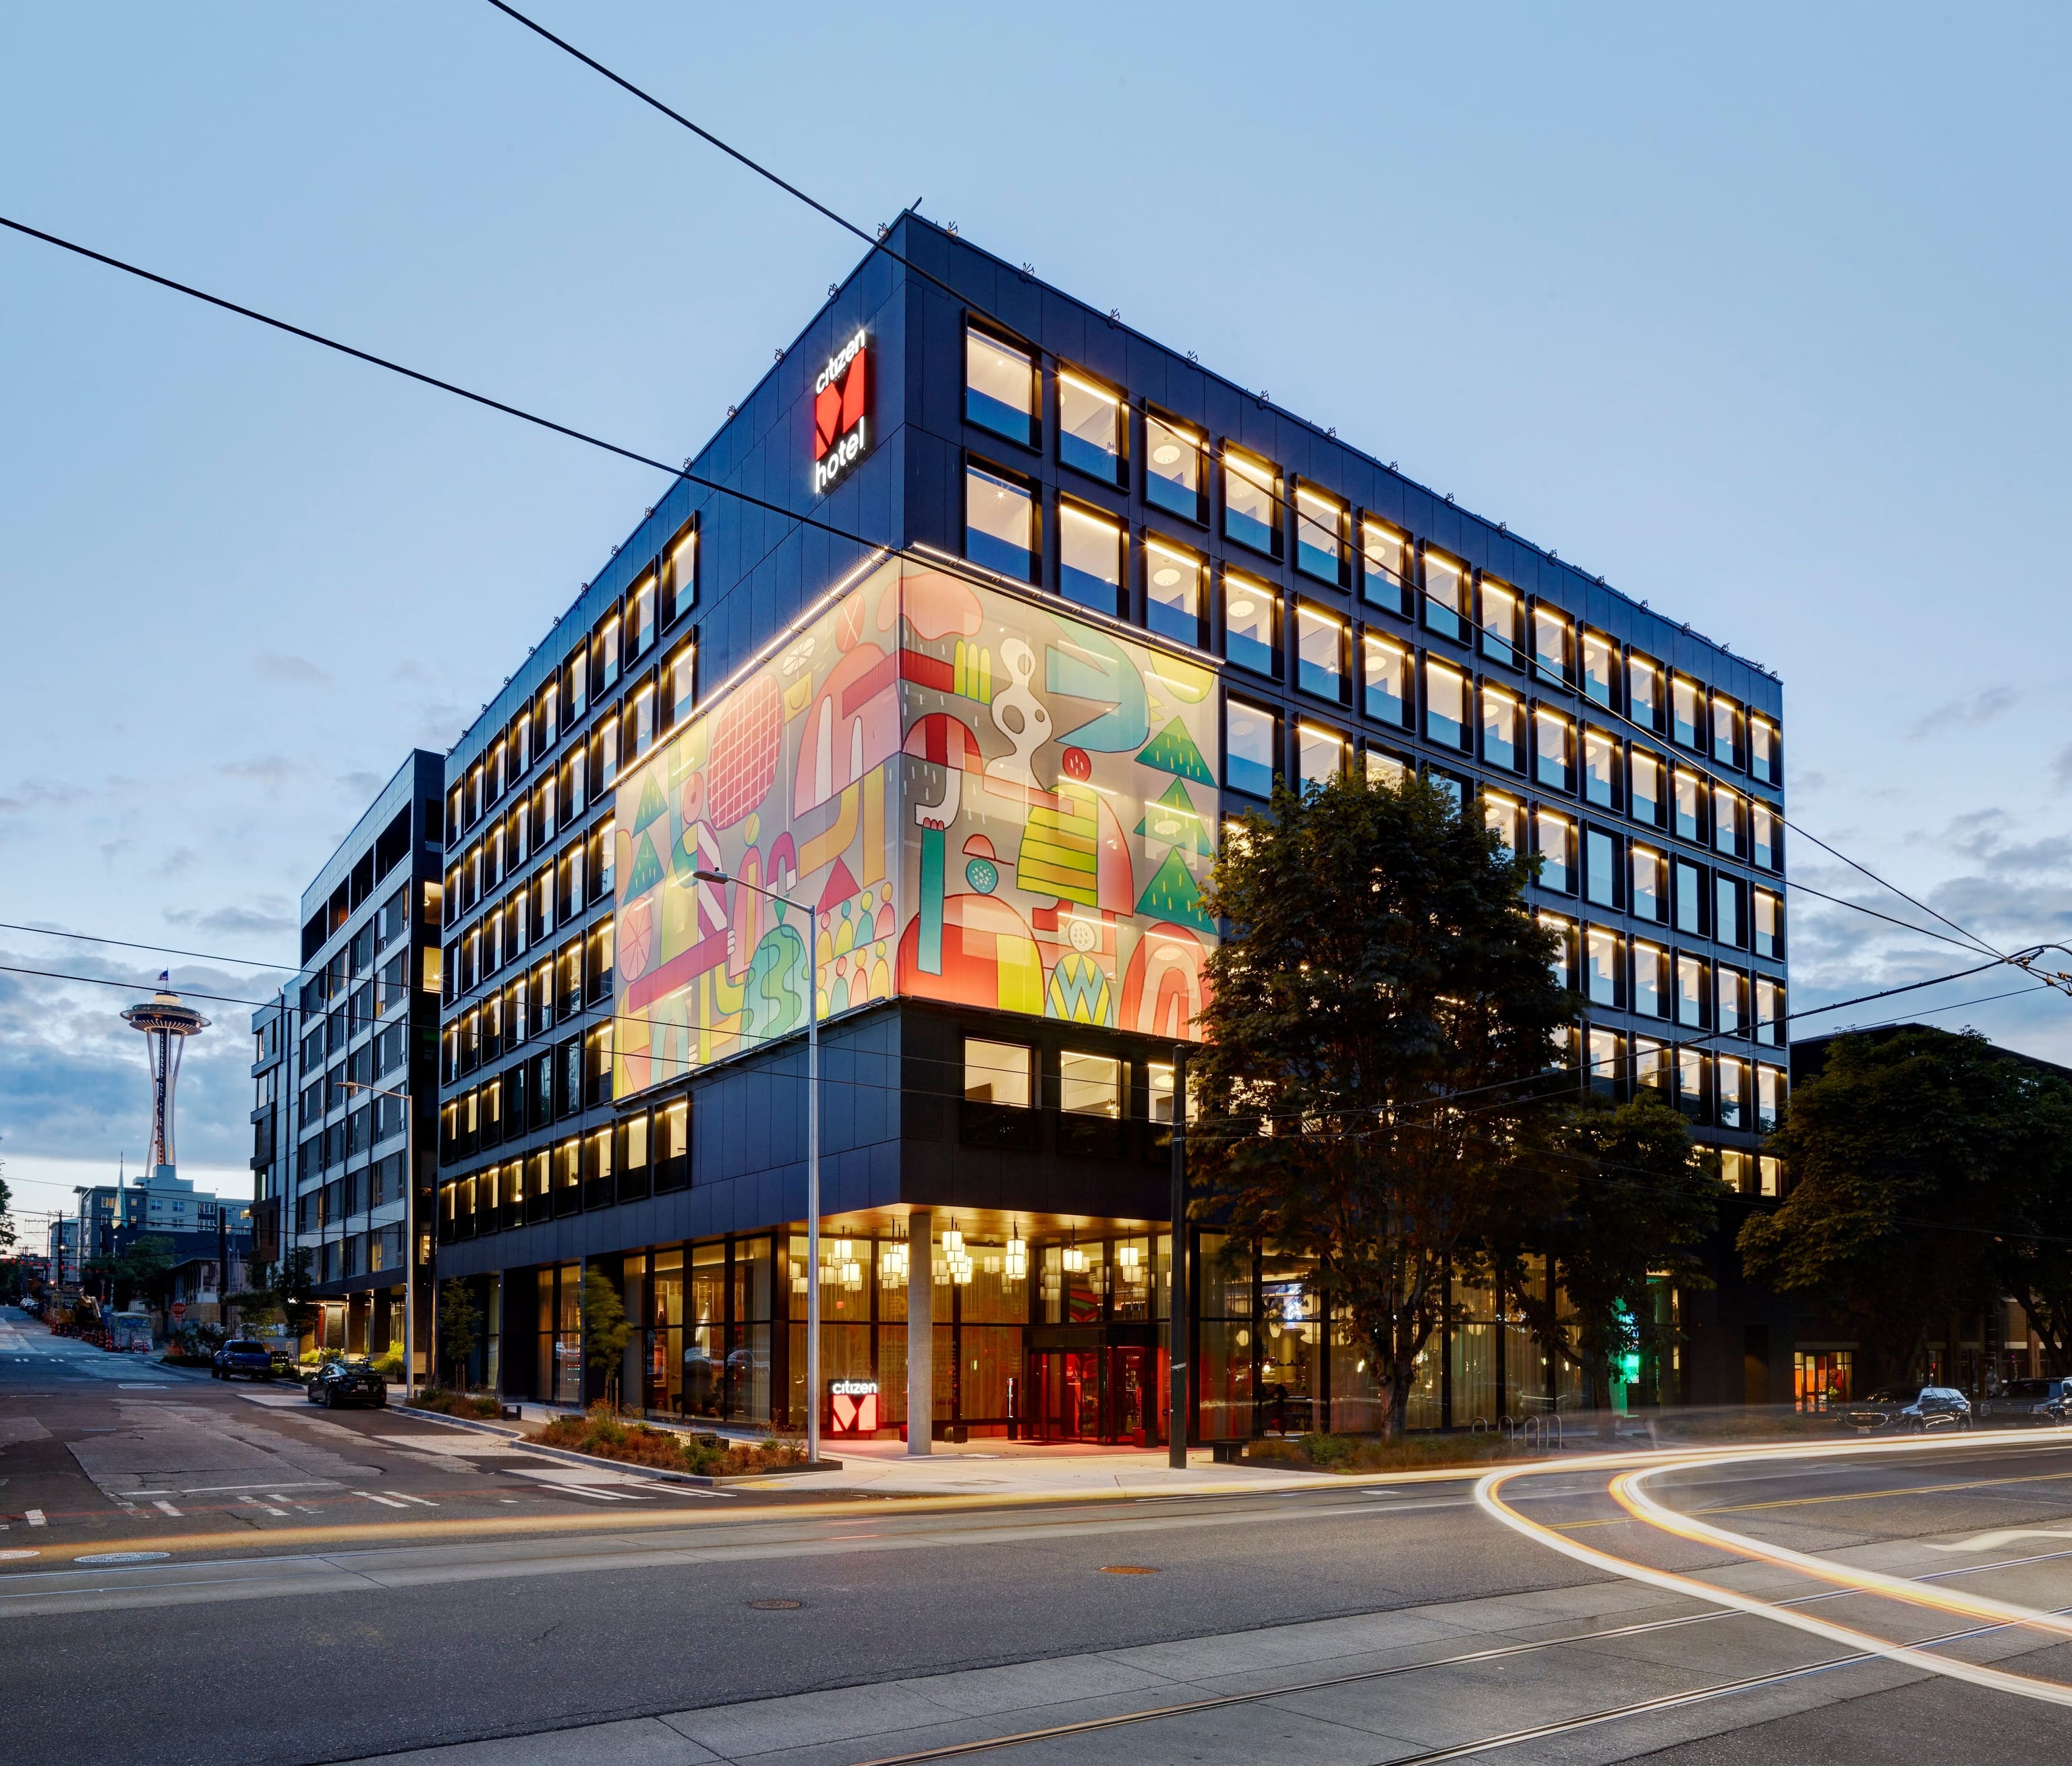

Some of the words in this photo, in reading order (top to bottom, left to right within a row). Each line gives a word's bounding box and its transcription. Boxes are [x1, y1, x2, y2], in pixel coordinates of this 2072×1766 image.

[815, 329, 865, 394] citizen
[815, 415, 865, 494] hotel
[832, 1380, 877, 1394] citizen
